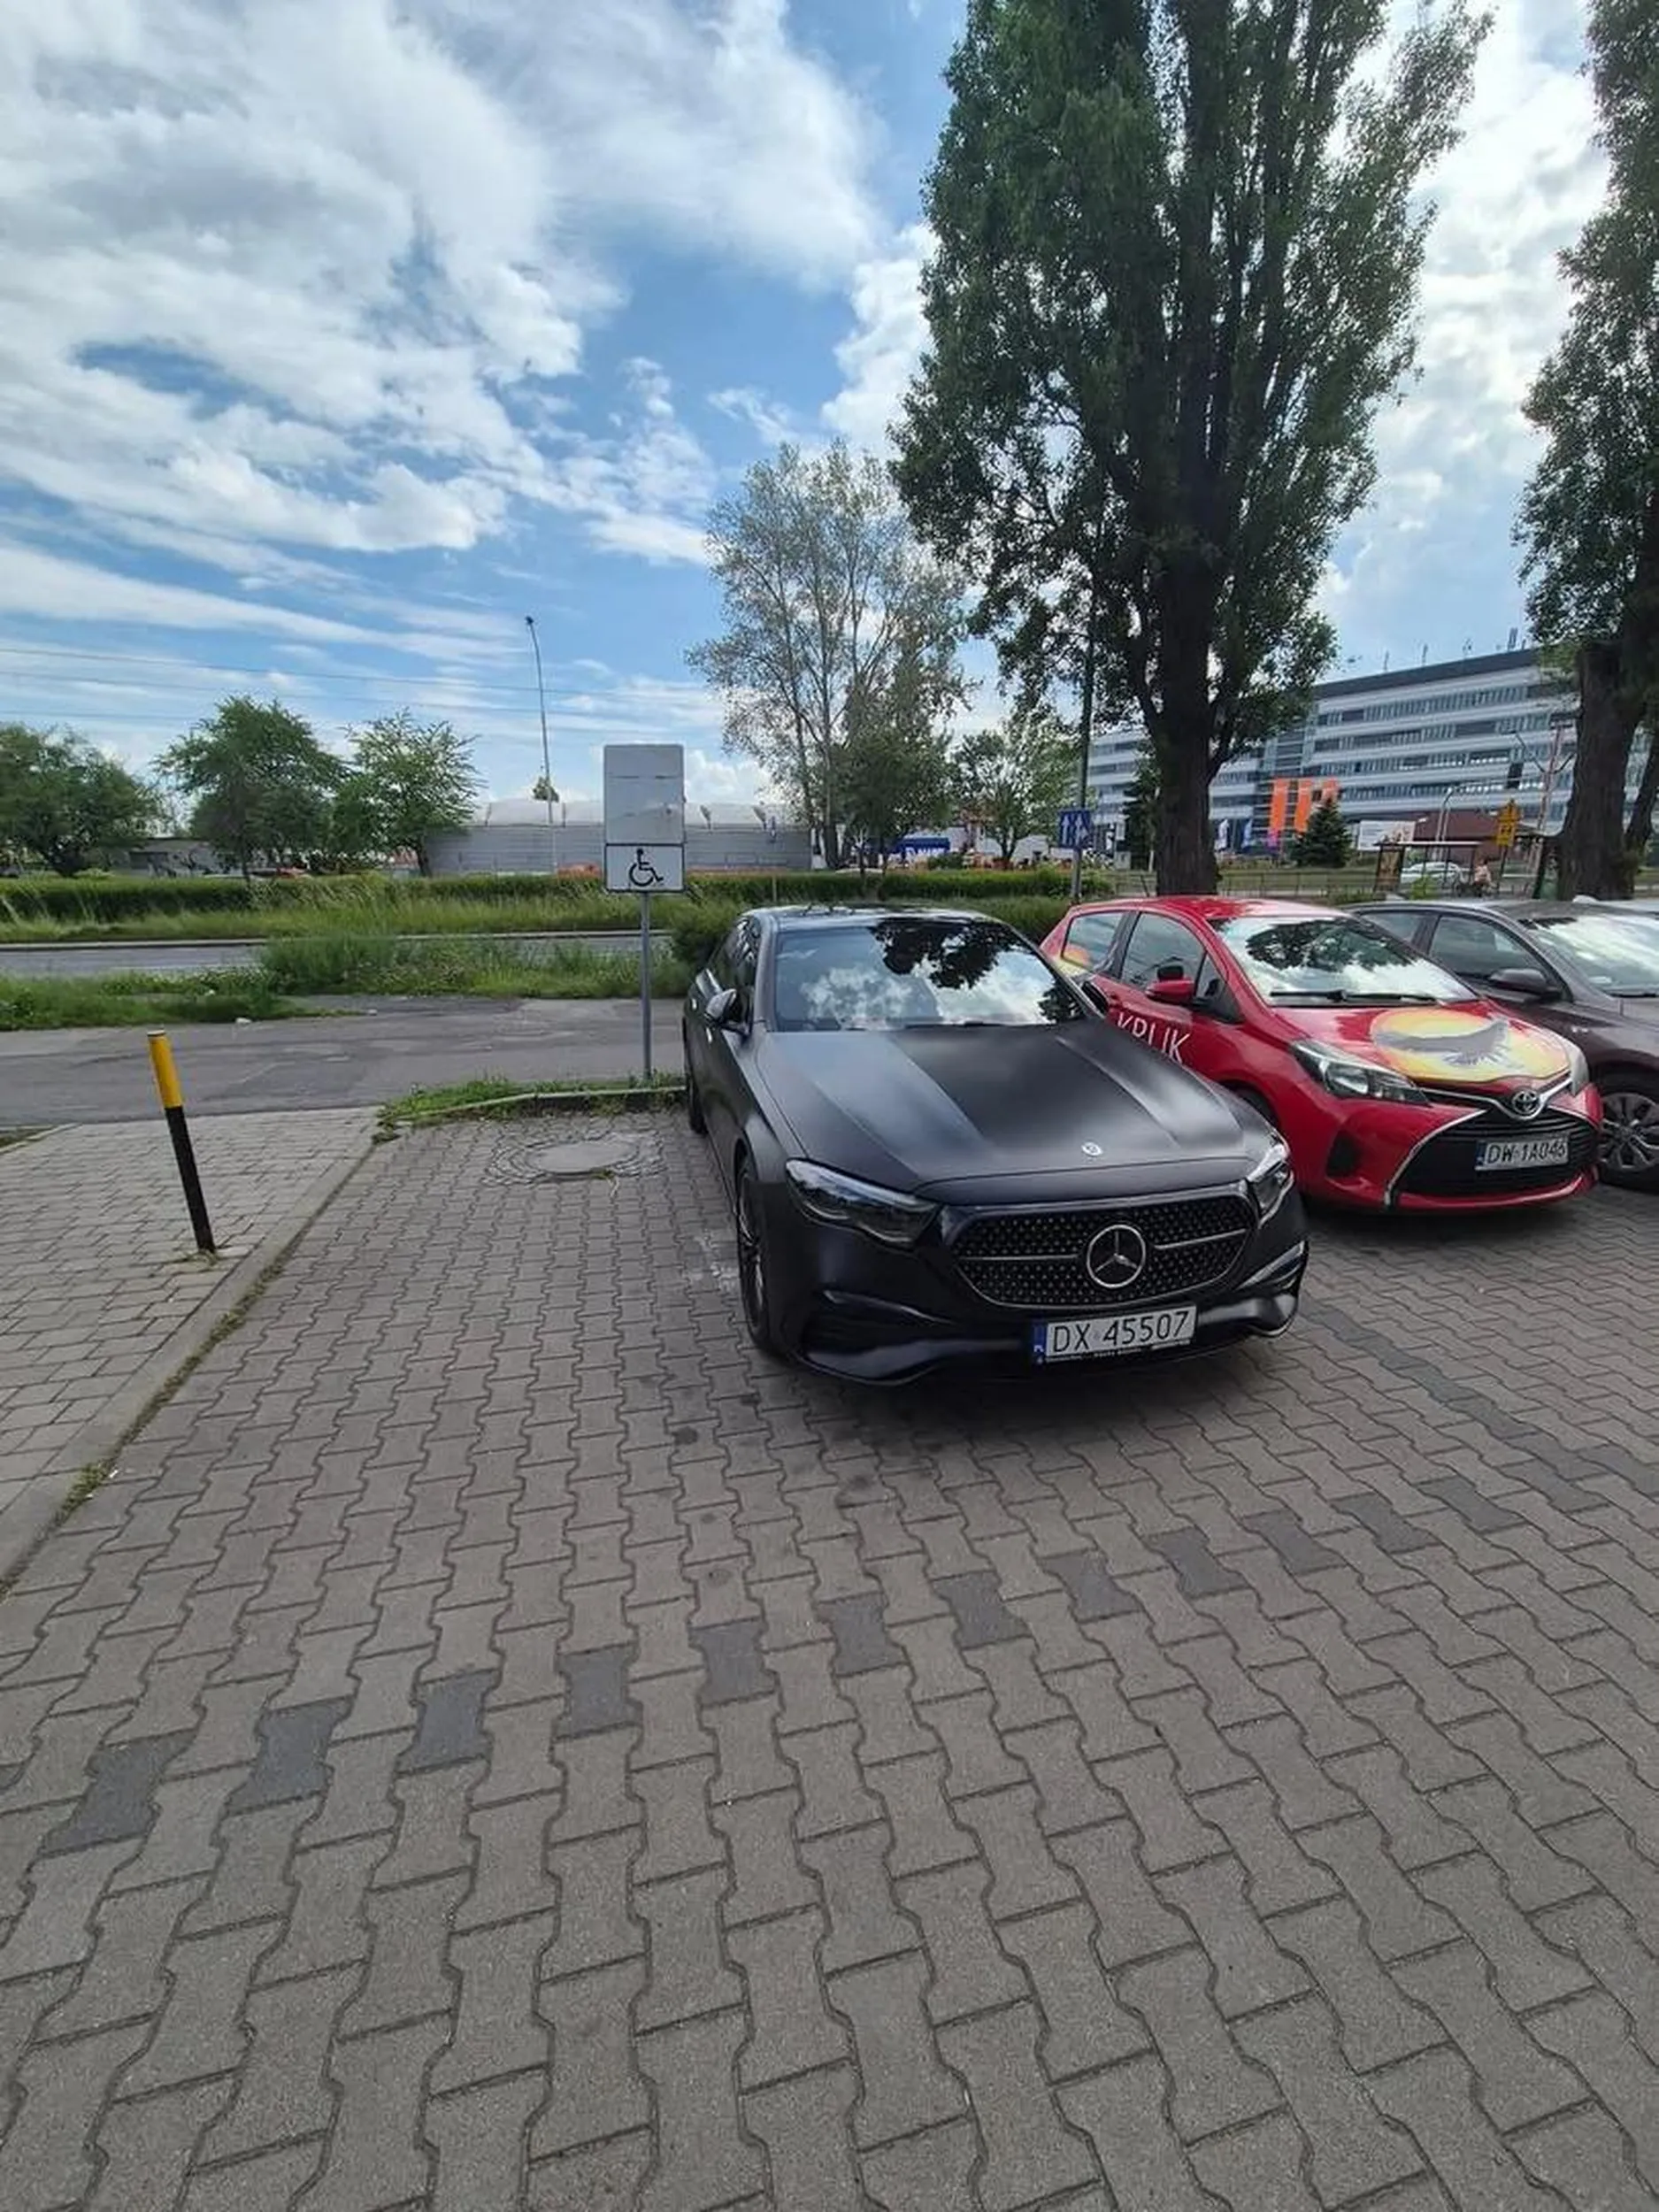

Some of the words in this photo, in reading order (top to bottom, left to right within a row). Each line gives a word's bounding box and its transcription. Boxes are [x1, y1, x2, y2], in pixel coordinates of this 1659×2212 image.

[1487, 1143, 1516, 1164] DW
[1053, 1322, 1091, 1353] DX
[1103, 1310, 1189, 1347] 45507
